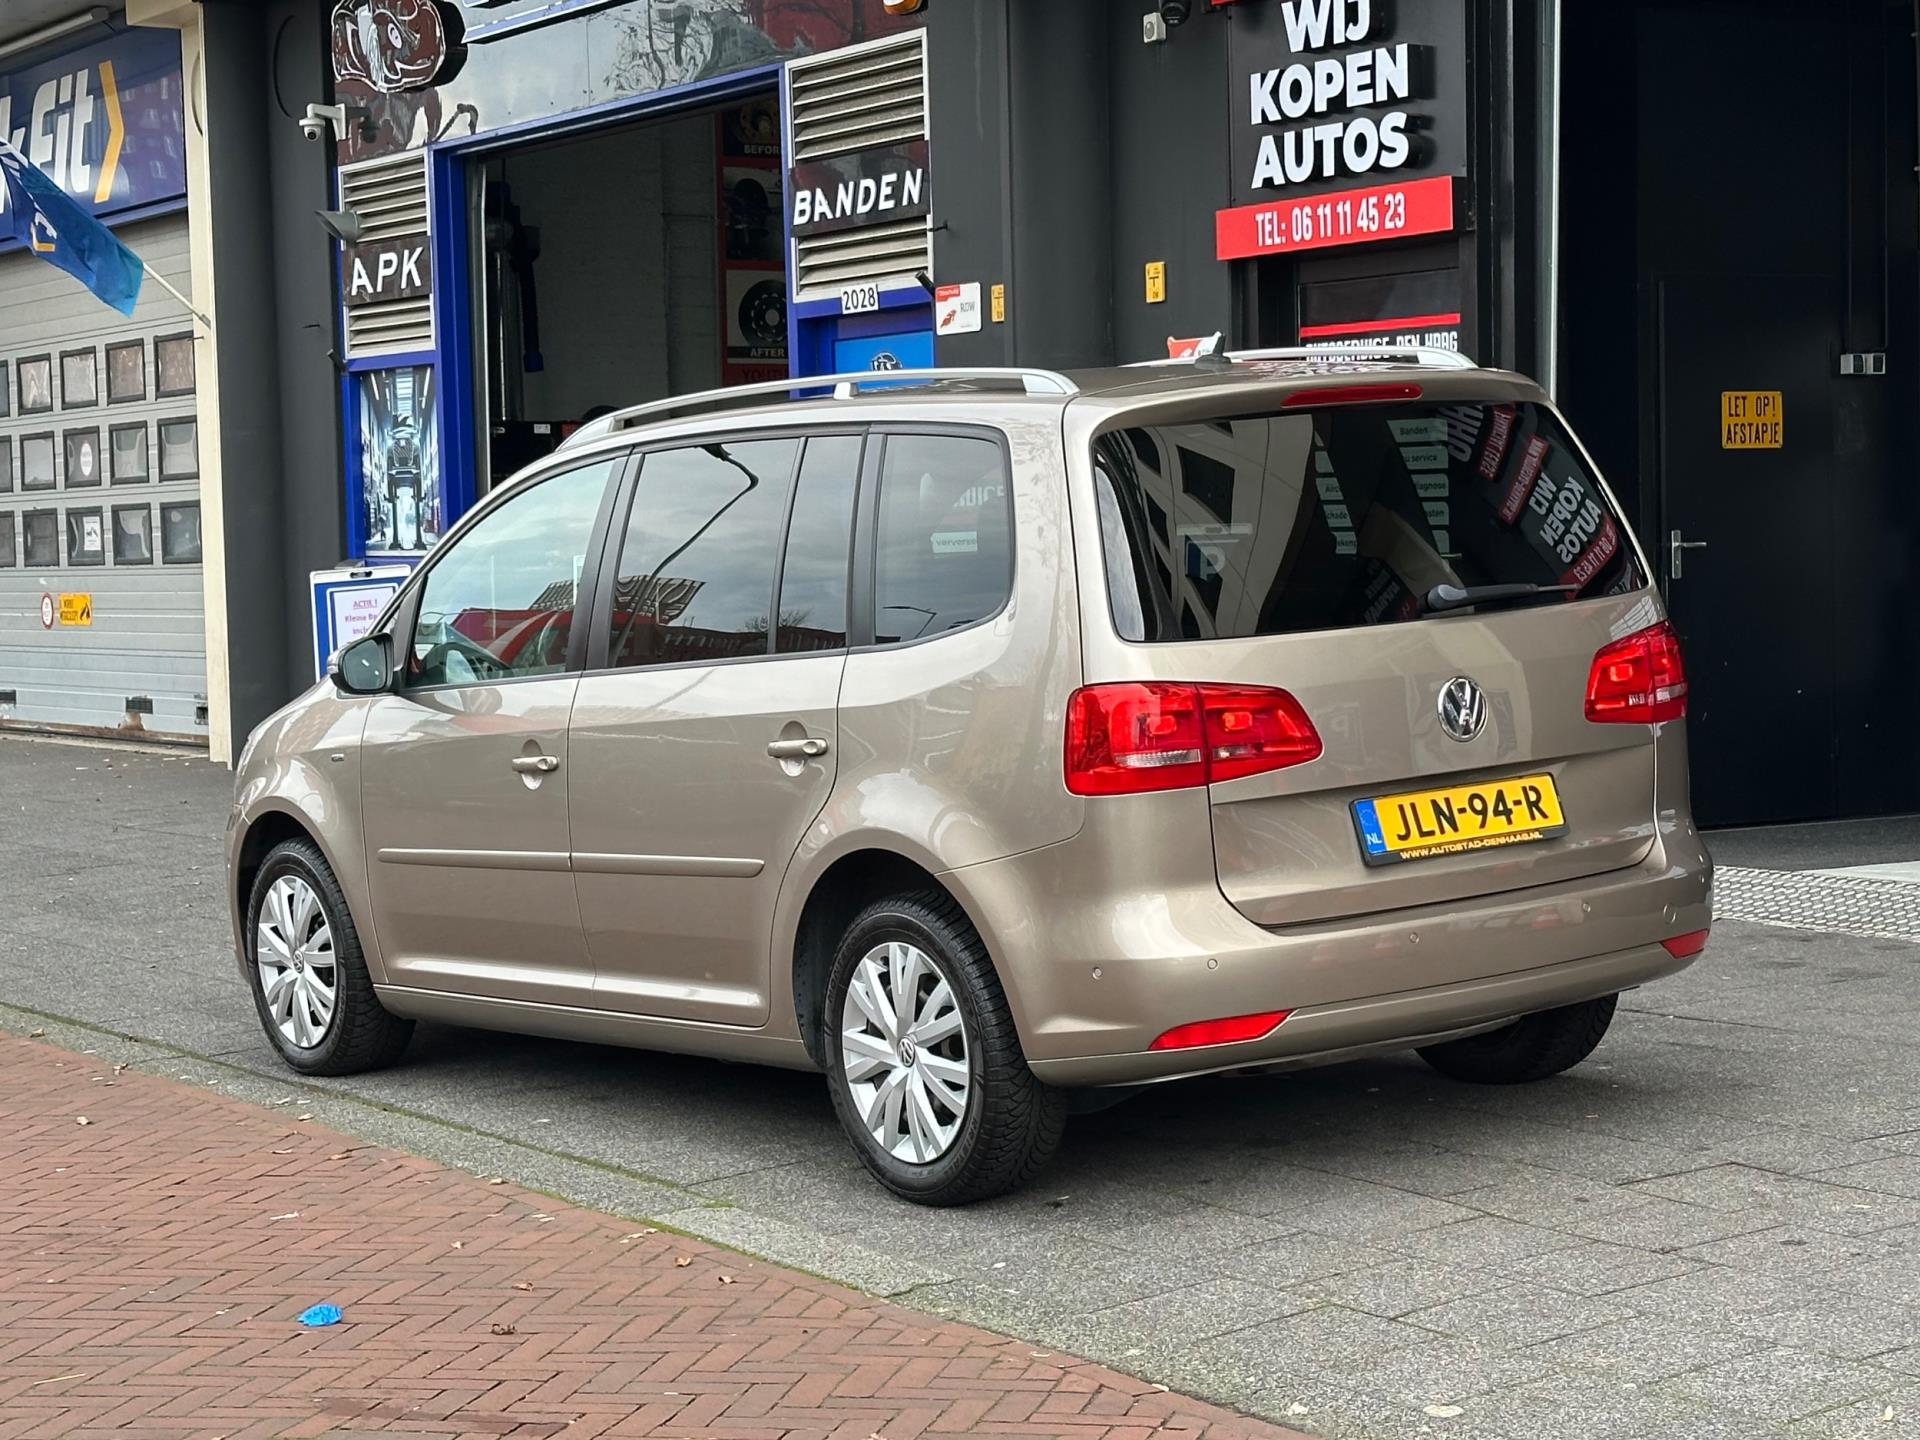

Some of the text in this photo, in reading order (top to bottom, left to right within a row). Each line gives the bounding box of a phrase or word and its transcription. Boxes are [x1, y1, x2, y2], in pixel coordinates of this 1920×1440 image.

[1281, 0, 1370, 53] WIJ
[1250, 43, 1409, 125] KOPEN
[744, 144, 780, 155] BEFOR
[1251, 112, 1409, 188] AUTOS
[793, 168, 923, 225] BANDEN
[1255, 191, 1406, 247] TEL: 06 11 11 45 23
[350, 246, 424, 296] APK
[842, 287, 877, 311] 2028
[750, 347, 786, 358] AFTER
[1424, 331, 1458, 352] HAAG
[1727, 395, 1776, 418] LET OP!
[1725, 422, 1780, 445] AFSTAPJE
[1396, 784, 1549, 842] JLN-94-R
[1366, 832, 1383, 846] NL
[1400, 830, 1544, 860] WWW.AUTOSTAD-DENHAAG.NL
